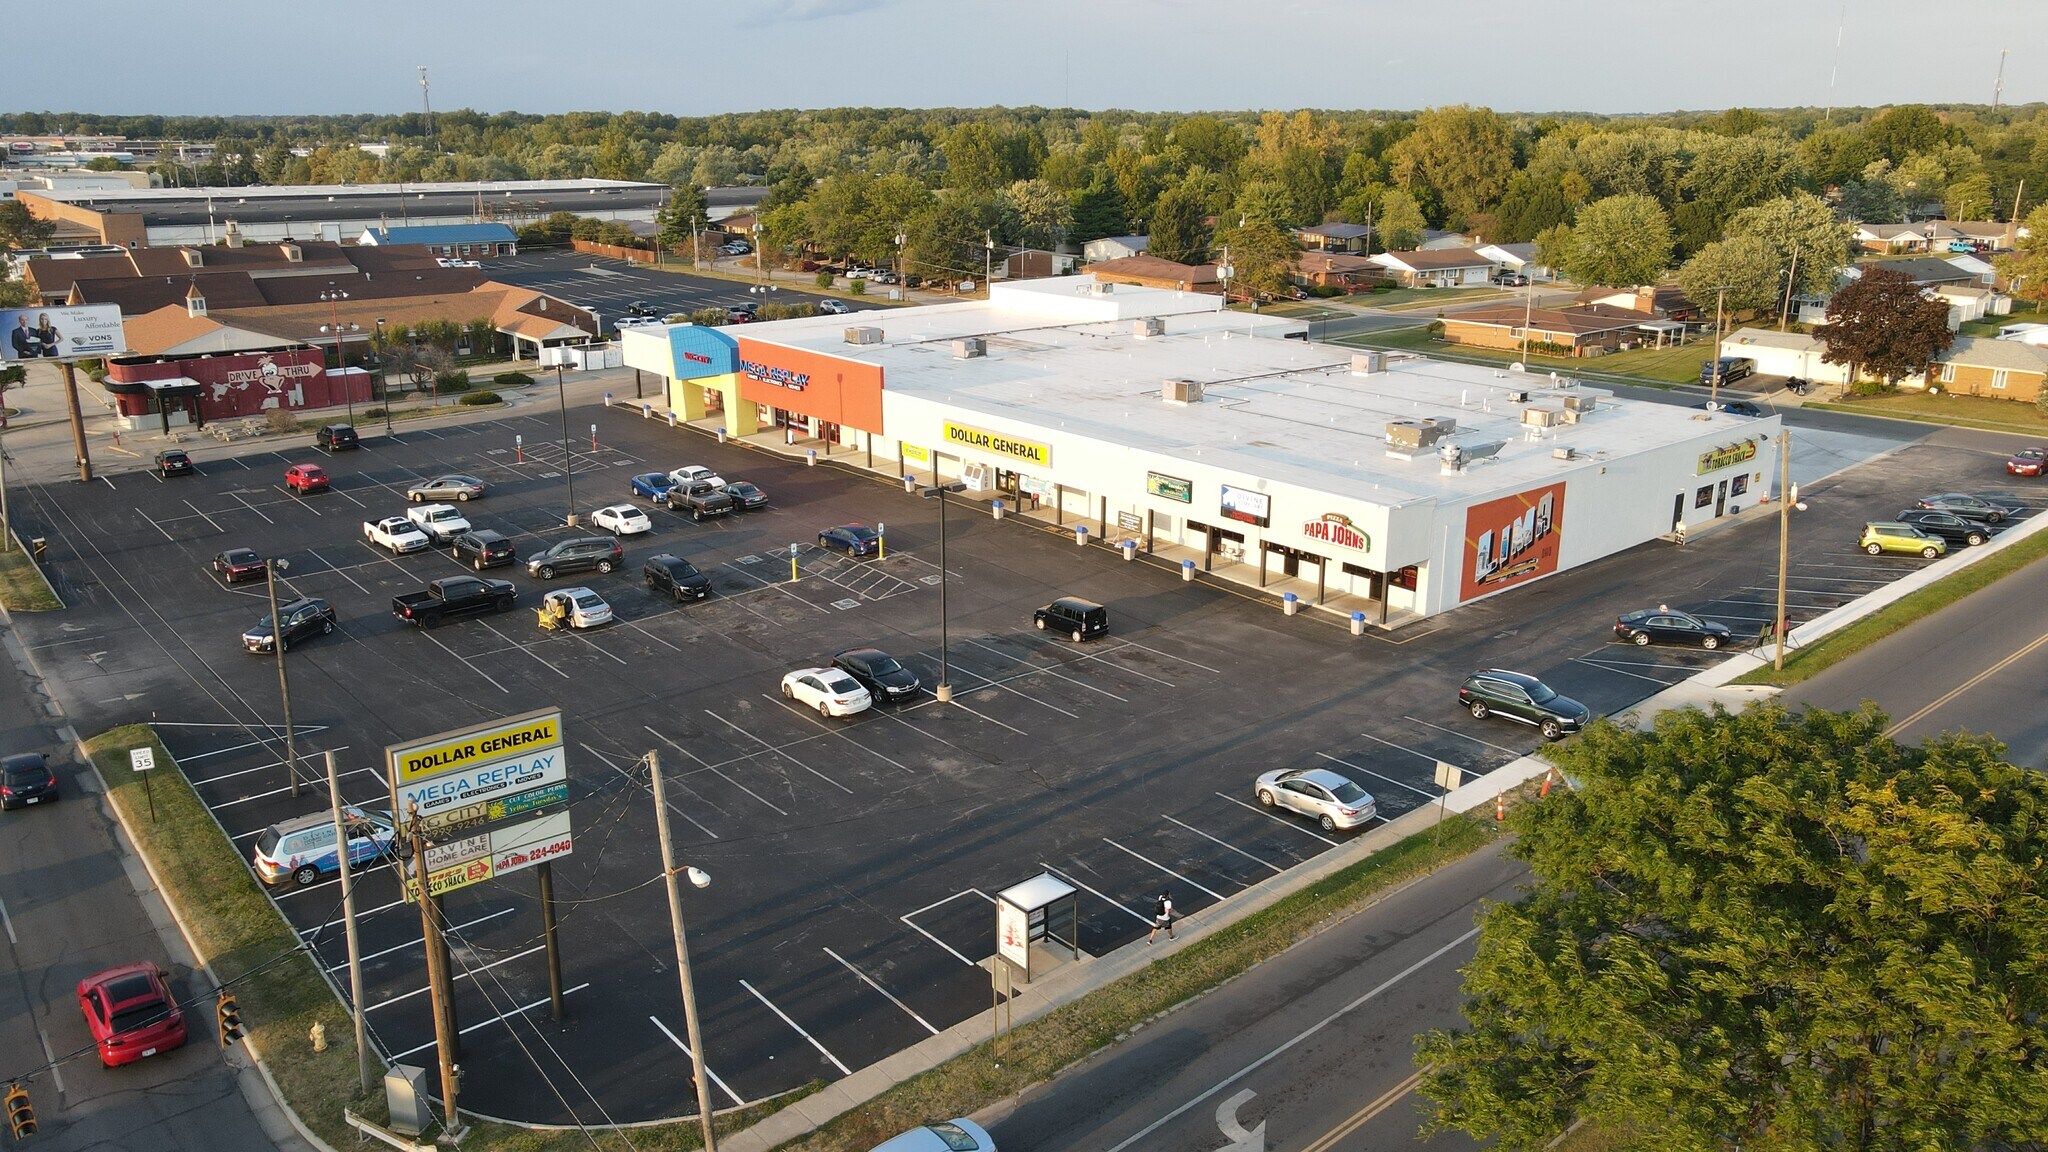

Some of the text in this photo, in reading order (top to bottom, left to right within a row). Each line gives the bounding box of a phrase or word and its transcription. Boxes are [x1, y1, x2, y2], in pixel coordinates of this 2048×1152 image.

[284, 366, 310, 376] THRU
[740, 360, 809, 387] MEGA REPLAY
[950, 427, 1040, 461] DOLLAR GENERAL
[1326, 514, 1343, 523] PIZZA
[1304, 522, 1364, 550] PAPA JOHNS
[1474, 490, 1554, 585] LIMA
[408, 726, 553, 772] DOLLAR GENERAL
[135, 758, 152, 769] 35
[407, 755, 555, 803] MEGA REPLAY
[426, 773, 542, 808] GAMES ELECTRONICS MOVIES
[524, 790, 545, 799] COLOR
[446, 803, 484, 823] CITY
[428, 835, 487, 858] DIVINE
[429, 851, 458, 866] HOME
[460, 842, 488, 857] CARE
[529, 839, 571, 861] 224-4040
[410, 873, 466, 897] TOCCO SHACK
